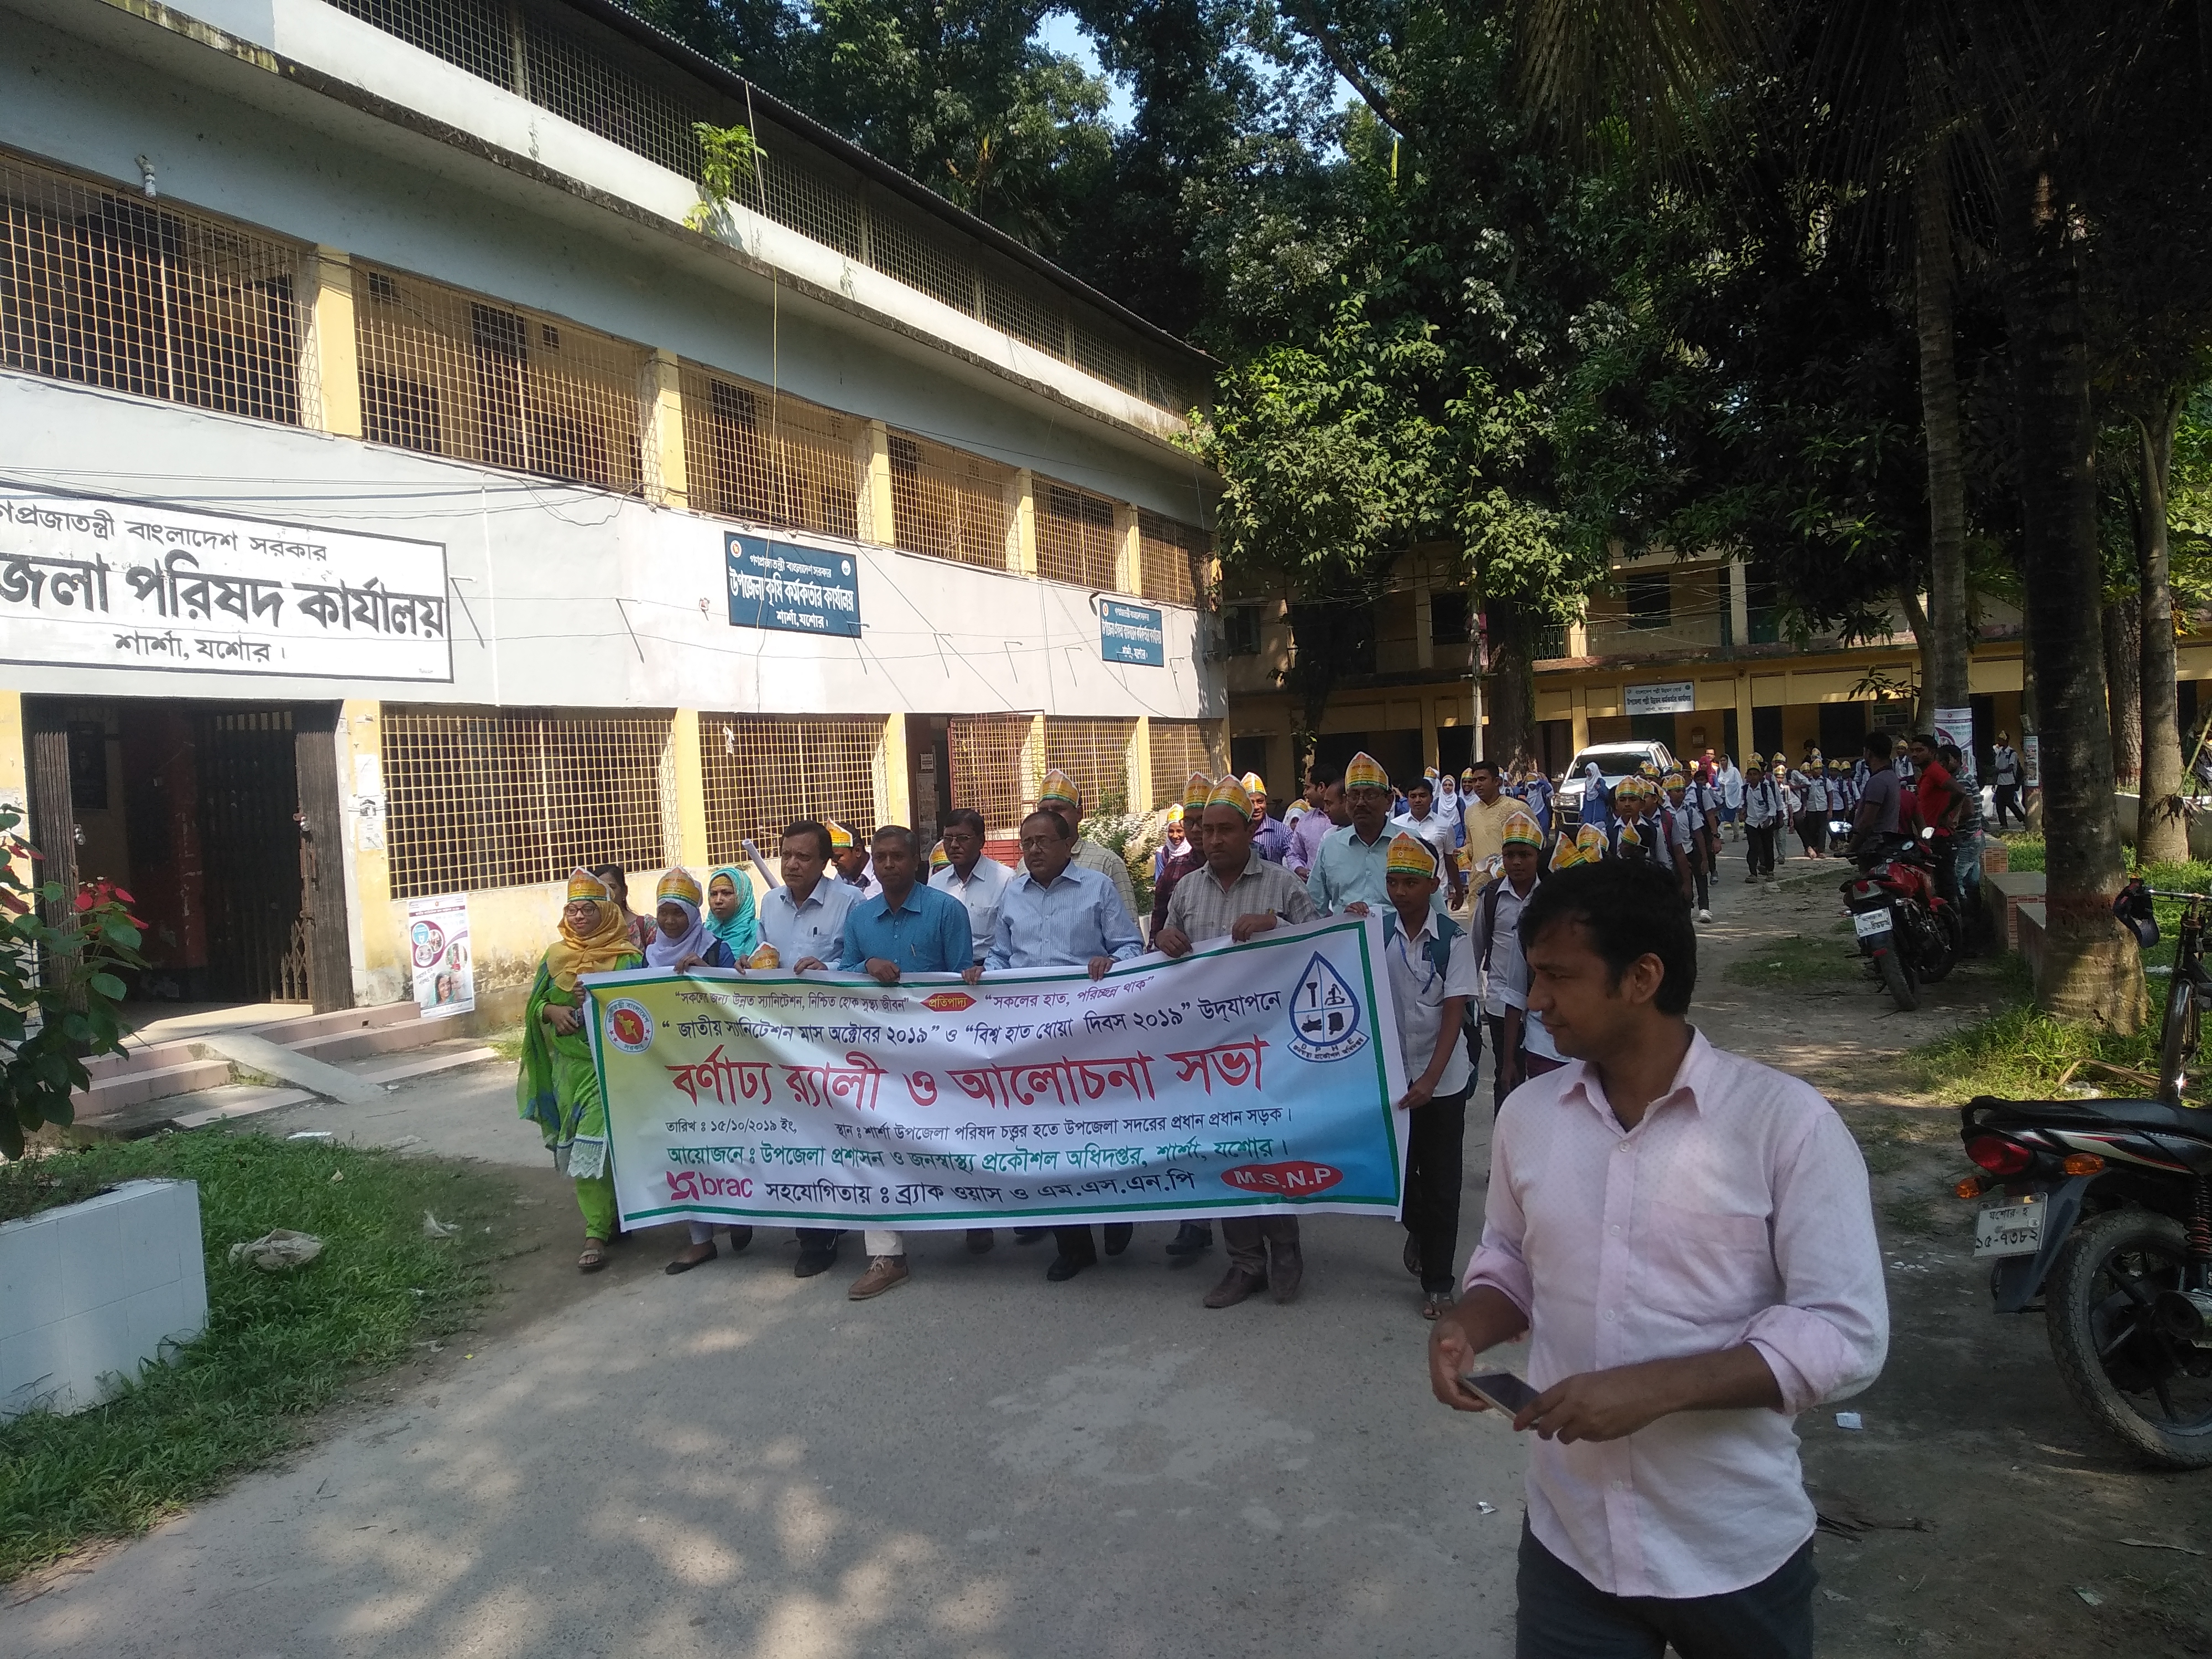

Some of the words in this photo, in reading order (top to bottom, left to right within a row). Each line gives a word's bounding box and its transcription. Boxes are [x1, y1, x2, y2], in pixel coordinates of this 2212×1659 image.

[124, 520, 238, 551] বাংলাদেশ
[250, 536, 327, 561] সরকার
[749, 554, 785, 572] গণপ্রজাতন্ত্রী
[786, 561, 813, 575] বাংলাদেশ
[813, 567, 832, 578] সরকার
[126, 549, 284, 628] পরিষদ
[291, 576, 444, 638] কার্যালয়
[729, 566, 765, 601] উপজেলা
[765, 572, 784, 607] কৃষি
[784, 578, 823, 608] কর্মকর্তার
[822, 585, 854, 612] কার্যালয়
[113, 629, 189, 660] শার্শা,
[195, 635, 272, 662] যশোর
[709, 993, 731, 1005] জন্য
[732, 991, 756, 1010] উন্নত
[758, 992, 805, 1011] স্যানিটেশন,
[807, 992, 837, 1009] নিশ্চিত
[839, 997, 859, 1010] হোক
[928, 994, 968, 1008] প্রতিপাদ্য
[985, 994, 1040, 1009] “সকলের
[1044, 992, 1070, 1009] হাত,
[1077, 985, 1121, 1003] পরিচ্ছন্ন
[676, 1014, 722, 1039] জাতীয়
[724, 1016, 794, 1042] স্যানিটেশন
[797, 1024, 825, 1044] মাস
[828, 1020, 882, 1045] অক্টোবর
[945, 1029, 958, 1043] ও
[1005, 1024, 1034, 1045] হাত
[1036, 1016, 1074, 1040] ধোয়া
[1083, 1010, 1128, 1035] দিবস
[664, 1044, 774, 1107] বর্ণাঢ্য
[901, 1070, 938, 1107] ও
[943, 1049, 1156, 1110] আলোচনা
[1163, 1033, 1271, 1097] সভা
[665, 1118, 697, 1133] তারিখ
[711, 1118, 777, 1134] ১৫/১০/২০১৯
[780, 1117, 798, 1134] ইং,
[834, 1122, 853, 1139] স্থান
[863, 1122, 891, 1140] শার্শা
[893, 1122, 951, 1141] উপজেলা
[954, 1121, 998, 1141] পরিষদ
[1031, 1123, 1060, 1140] হতে
[1063, 1117, 1119, 1135] উপজেলা
[1121, 1117, 1168, 1132] সদরের
[1171, 1112, 1206, 1132] প্রধান
[1208, 1109, 1244, 1128] প্রধান
[1245, 1107, 1284, 1126] সড়ক
[666, 1145, 745, 1165] আয়োজনে
[759, 1140, 827, 1167] উপজেলা
[831, 1146, 885, 1168] প্রশাসন
[889, 1152, 905, 1165] ও
[906, 1151, 978, 1175] জনস্বাস্থ্য
[982, 1145, 1061, 1173] প্রকৌশল
[1065, 1141, 1148, 1170] অধিদপ্তর,
[1156, 1135, 1208, 1162] শার্শা,
[1213, 1136, 1274, 1159] যশোর
[698, 1171, 754, 1198] brac
[764, 1177, 873, 1204] সহযোগিতায়
[895, 1181, 945, 1207] ব্র্যাক
[950, 1186, 1004, 1203] ওয়াস
[1009, 1188, 1029, 1200] ও
[1037, 1167, 1196, 1198] এম.এস.এন.পি
[1233, 1167, 1332, 1189] M.S.N.P
[1989, 1209, 2016, 1220] যশোর
[2023, 1207, 2030, 1217] হ
[1975, 1229, 2038, 1249] ১৫-৭৩৮২
